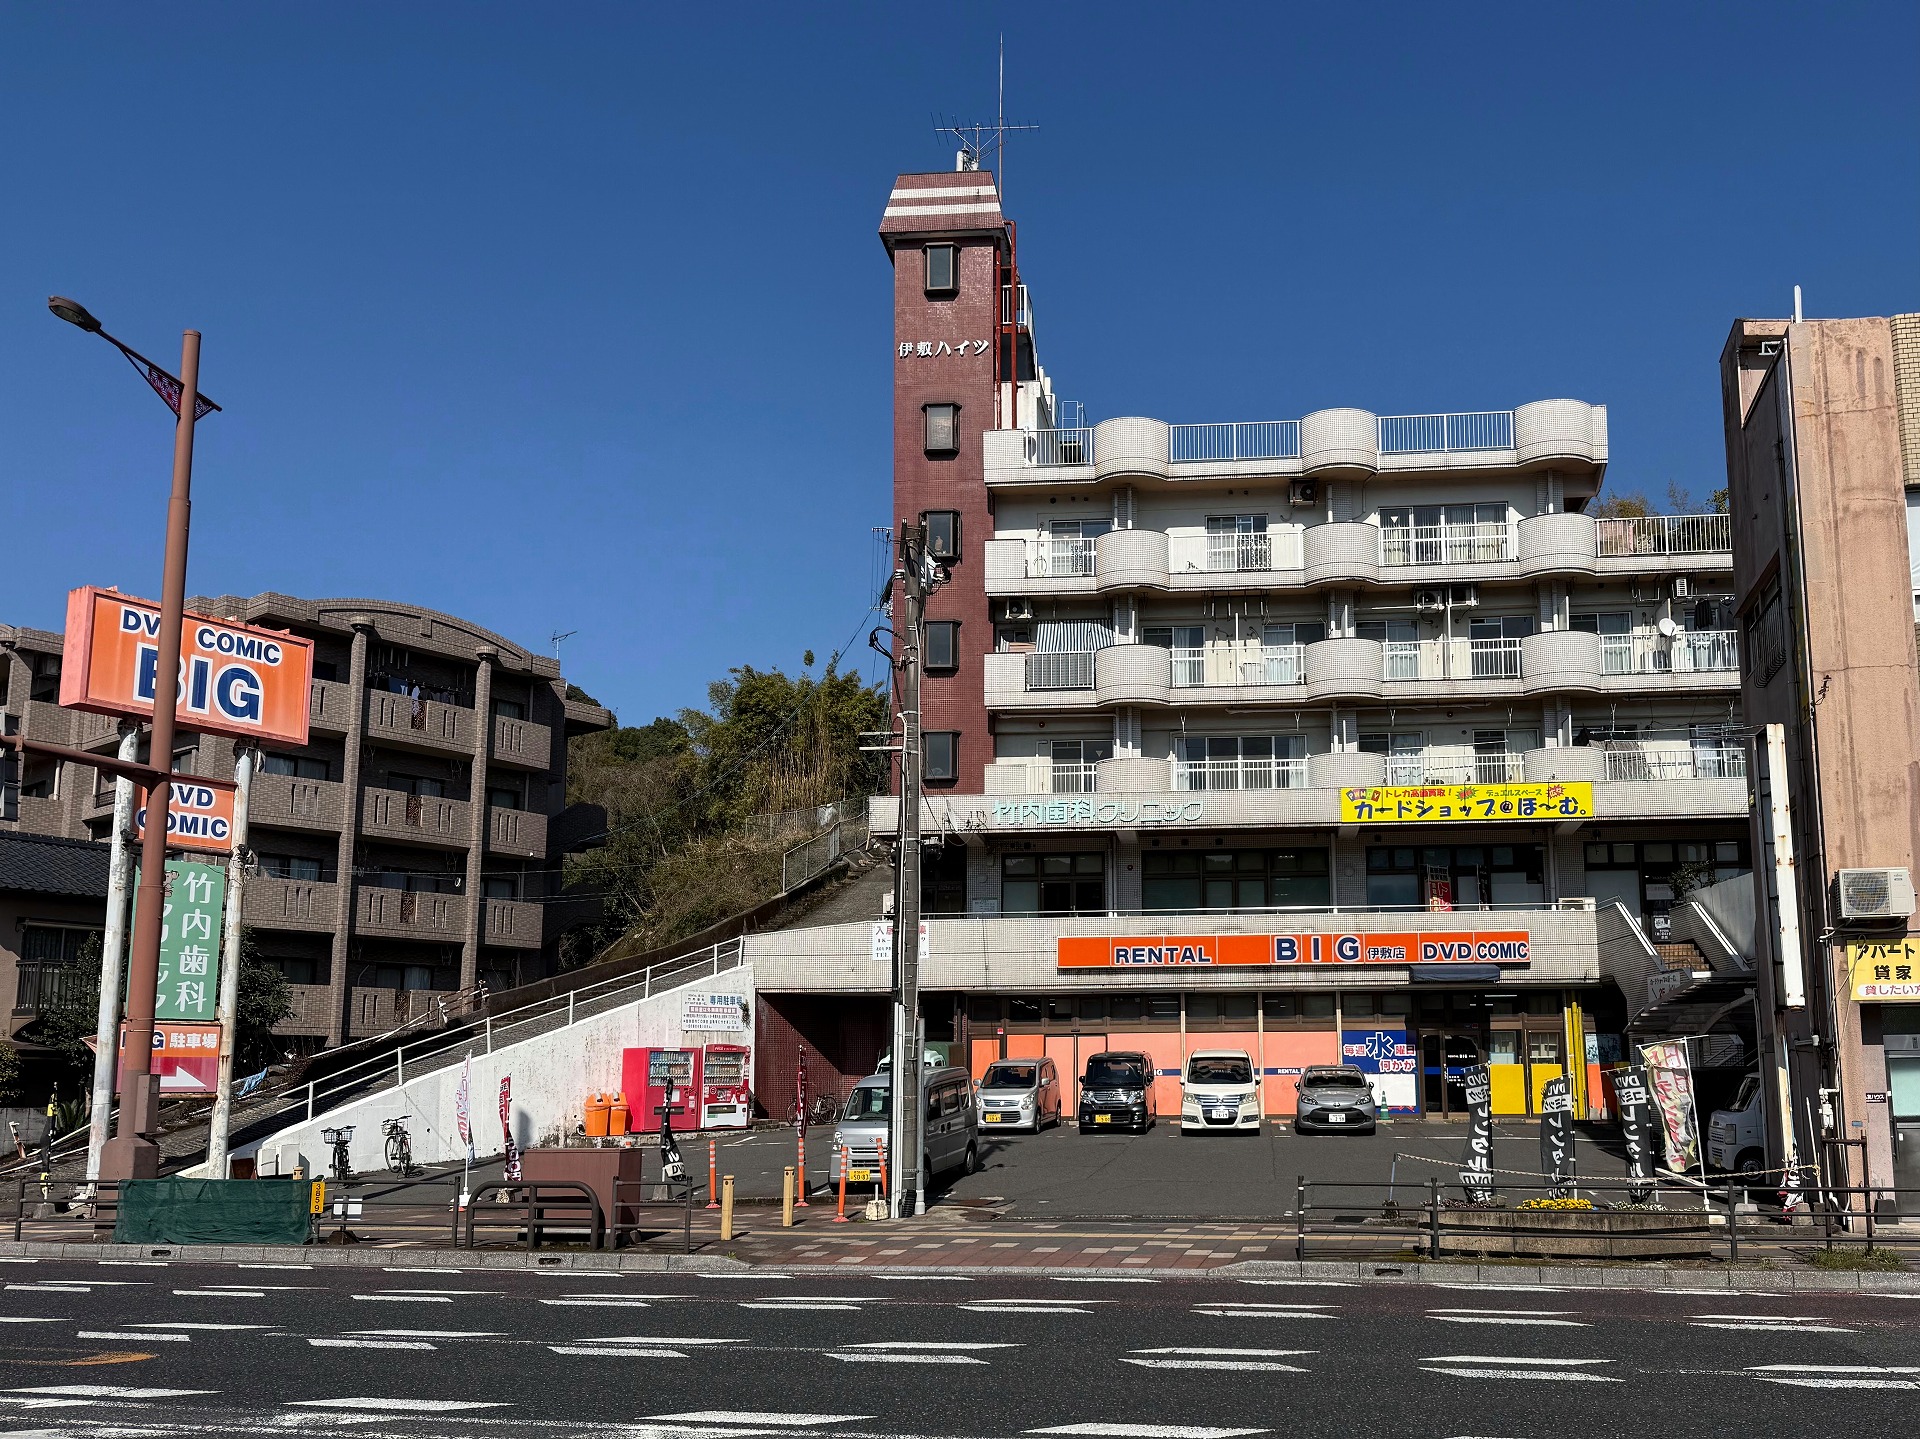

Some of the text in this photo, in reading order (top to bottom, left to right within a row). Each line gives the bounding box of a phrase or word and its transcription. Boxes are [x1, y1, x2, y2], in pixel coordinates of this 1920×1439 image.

[898, 340, 990, 358] 伊敷ハイツ
[123, 610, 281, 664] DV COMIC
[991, 799, 1204, 825] 竹内歯科クリニック
[175, 871, 215, 1013] 竹内歯科
[1115, 936, 1528, 964] RENTAL BIG 伊敷店 DVD COMIC
[1857, 943, 1916, 961] アパート
[1874, 965, 1912, 981] 貸家
[170, 1033, 217, 1049] 駐車場
[1343, 1031, 1416, 1060] 毎週水曜日
[1379, 1059, 1416, 1072] 何かが
